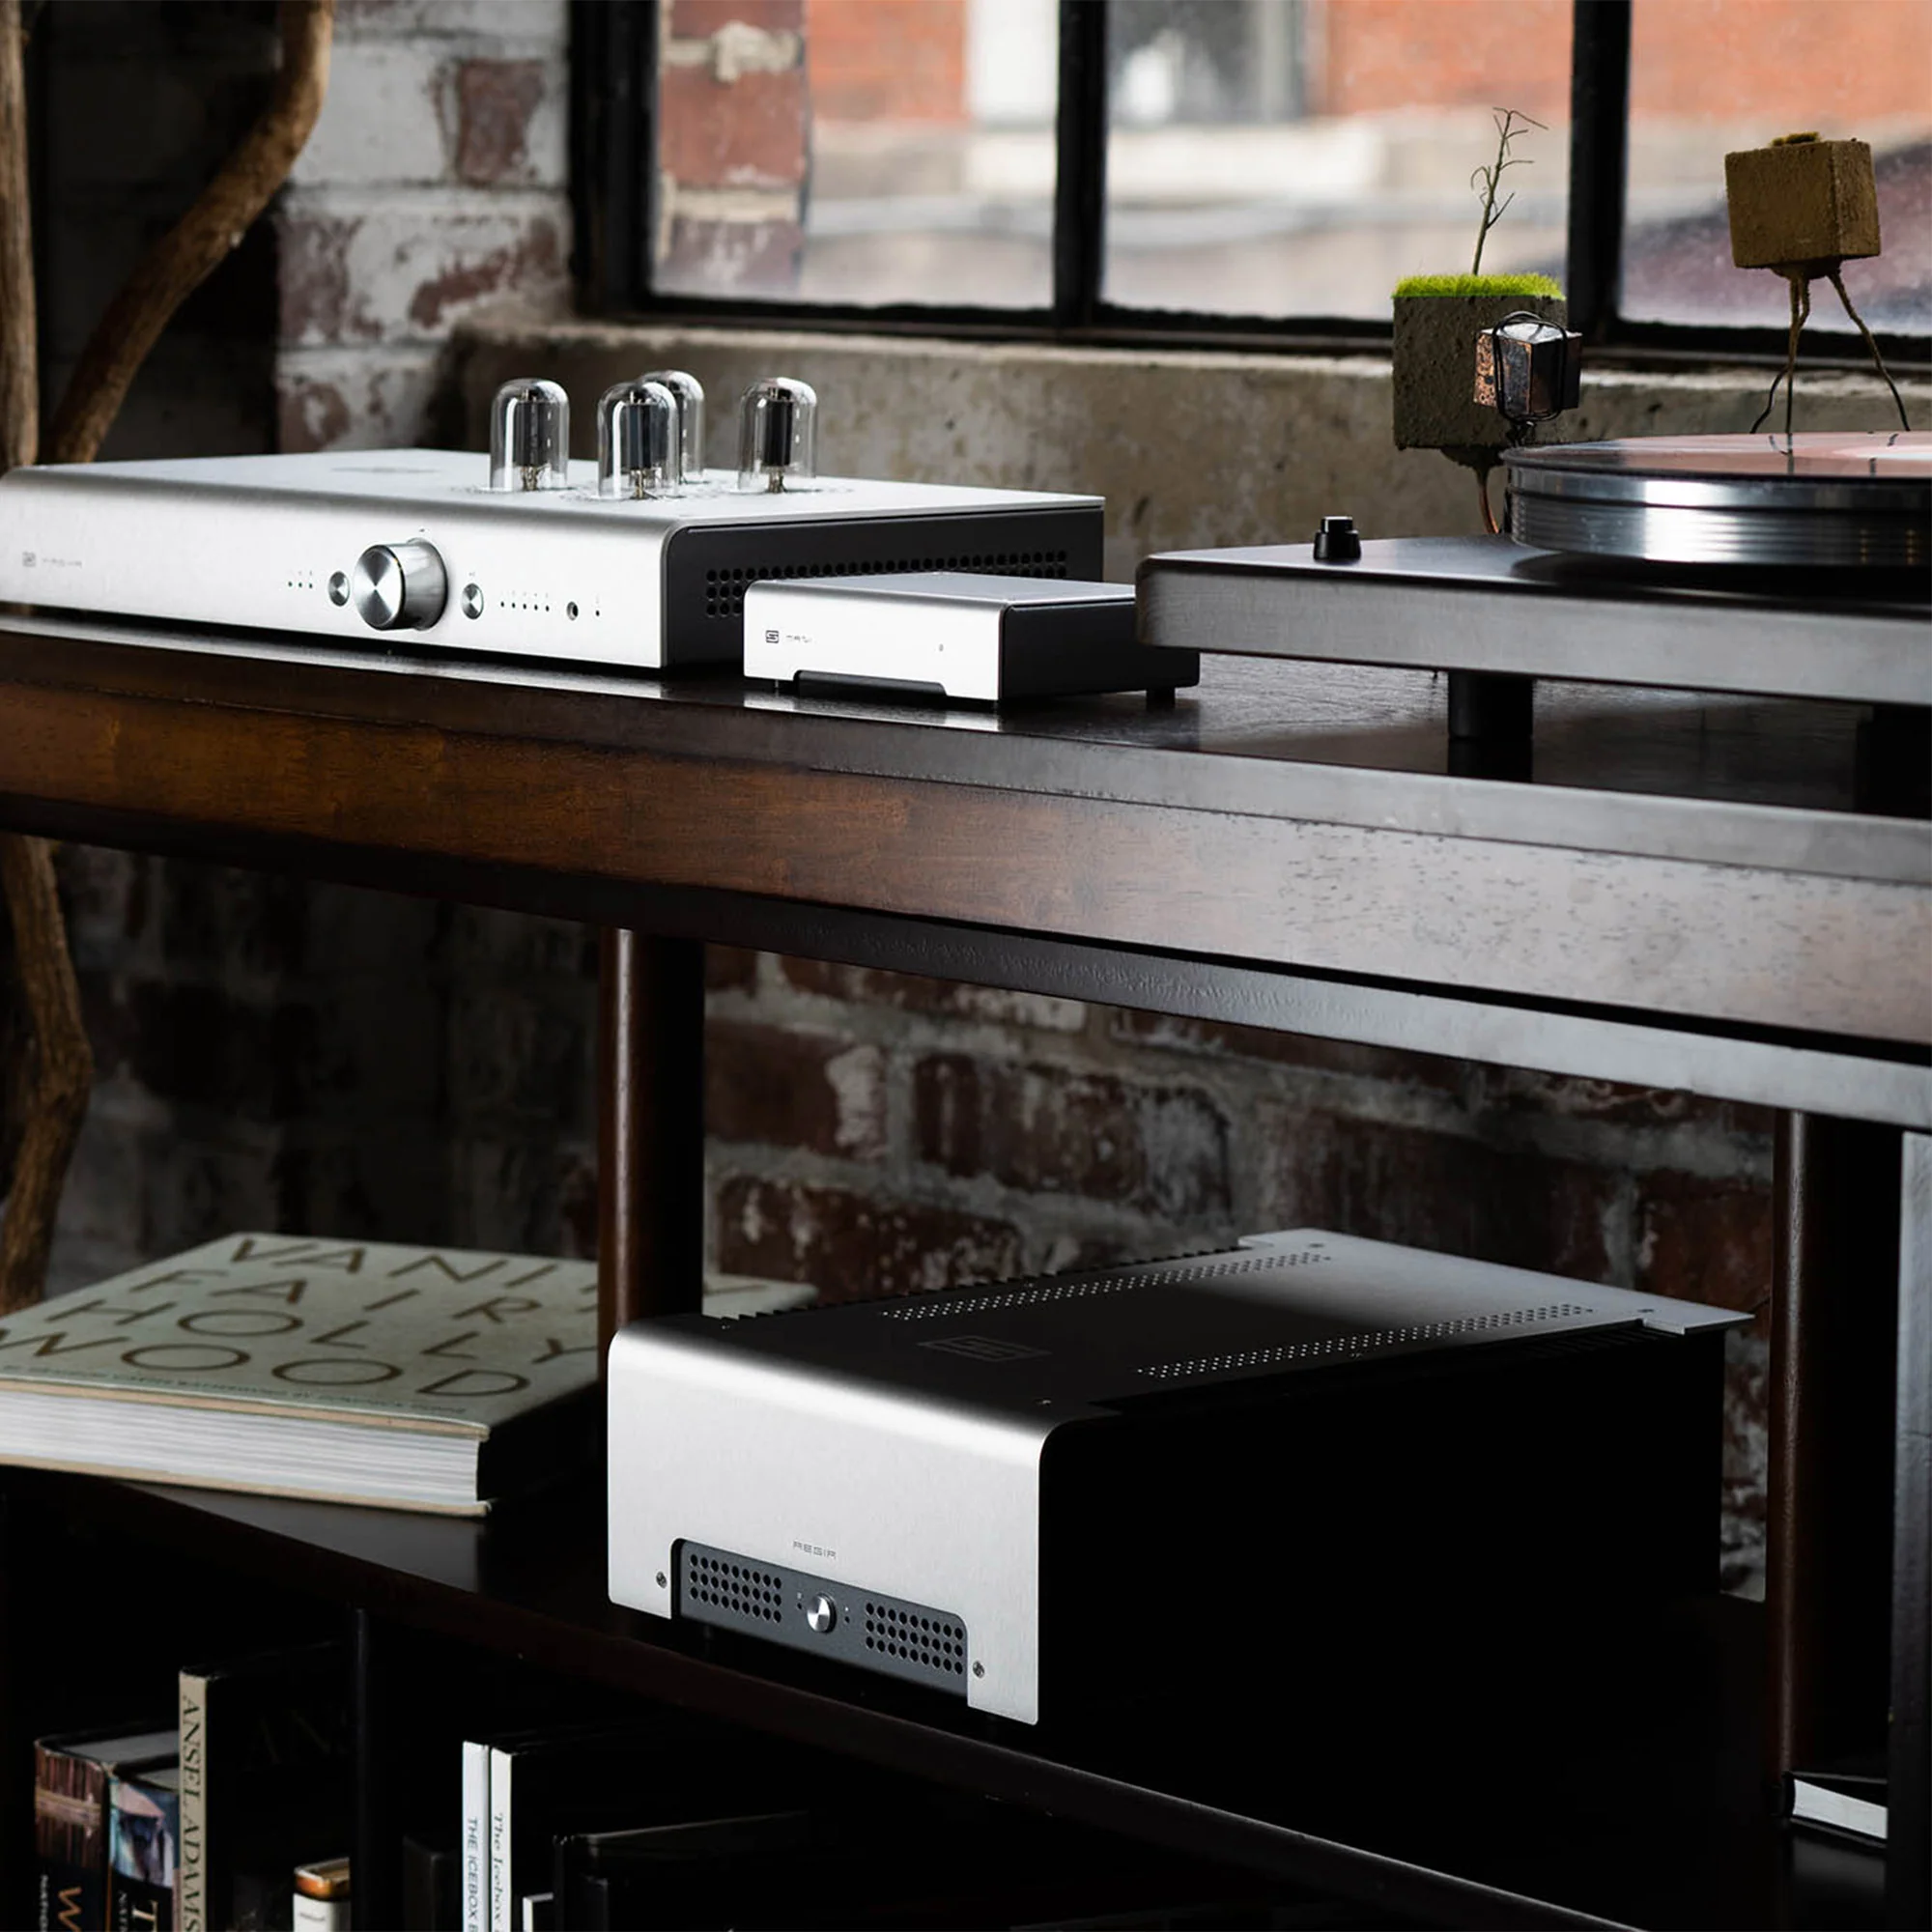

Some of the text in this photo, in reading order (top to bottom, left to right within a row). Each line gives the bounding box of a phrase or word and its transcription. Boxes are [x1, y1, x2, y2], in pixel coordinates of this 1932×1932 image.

[129, 1269, 597, 1324] FAIR
[230, 1238, 597, 1293] VANI
[0, 1328, 529, 1397] WOOD
[44, 1299, 597, 1364] HOLLY
[183, 1694, 201, 1932] ANSEL ADAMS
[468, 1817, 478, 1851] THE
[468, 1855, 478, 1920] ICEBOX
